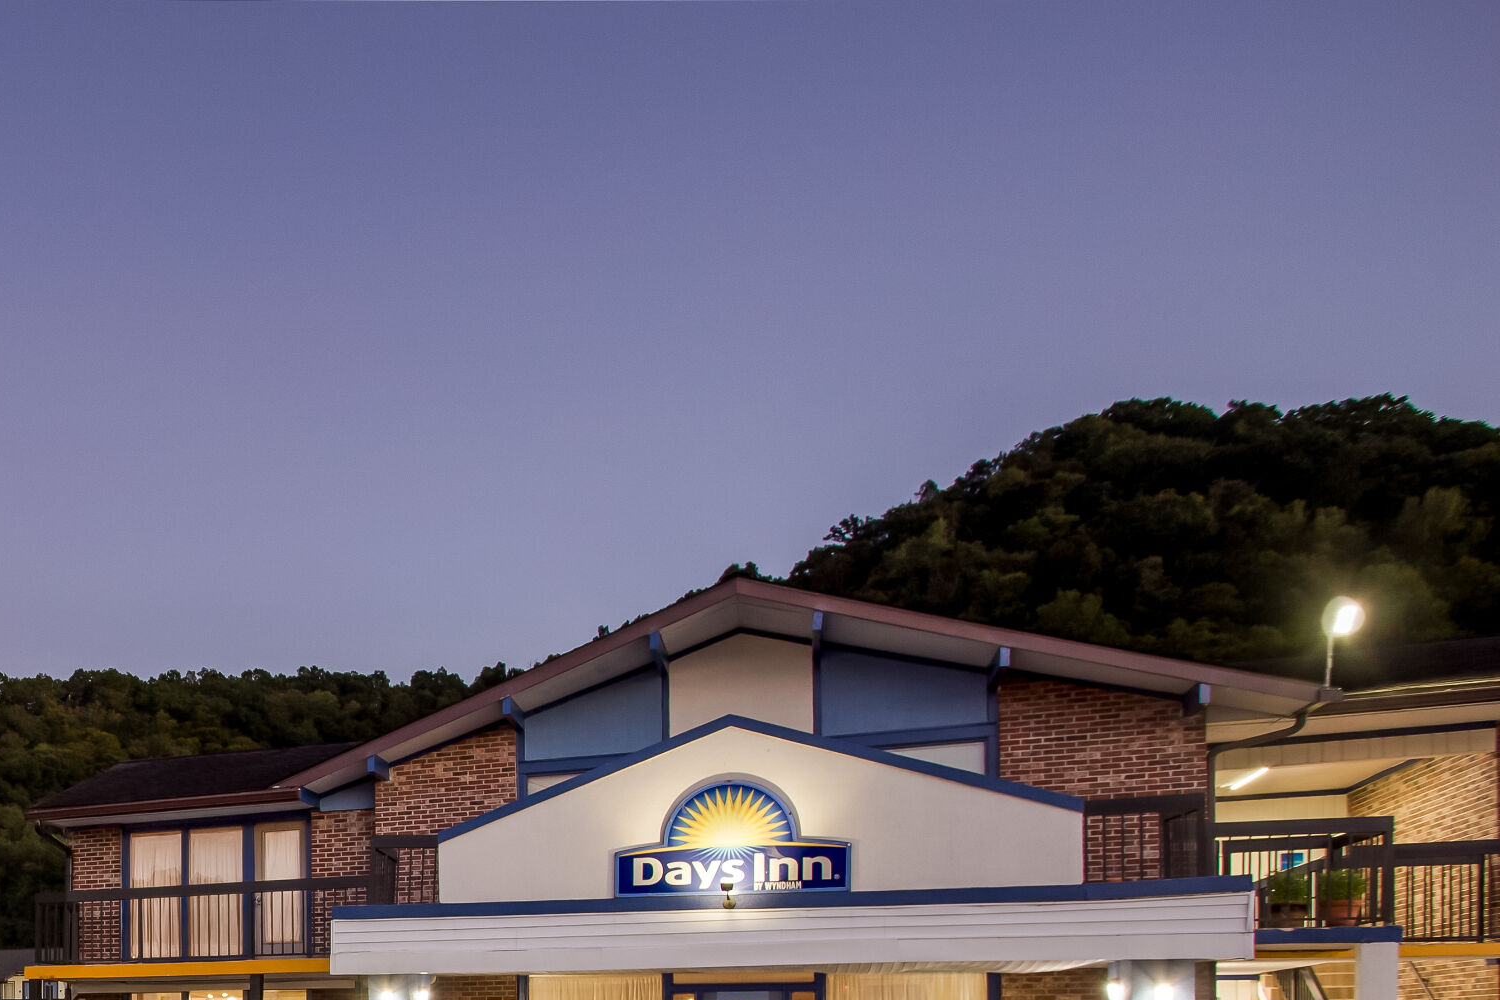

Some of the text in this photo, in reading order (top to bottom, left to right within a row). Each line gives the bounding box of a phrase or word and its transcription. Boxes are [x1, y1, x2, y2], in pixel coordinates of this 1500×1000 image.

[632, 852, 832, 890] Days Inn
[753, 880, 803, 891] BY WYNDHAM
